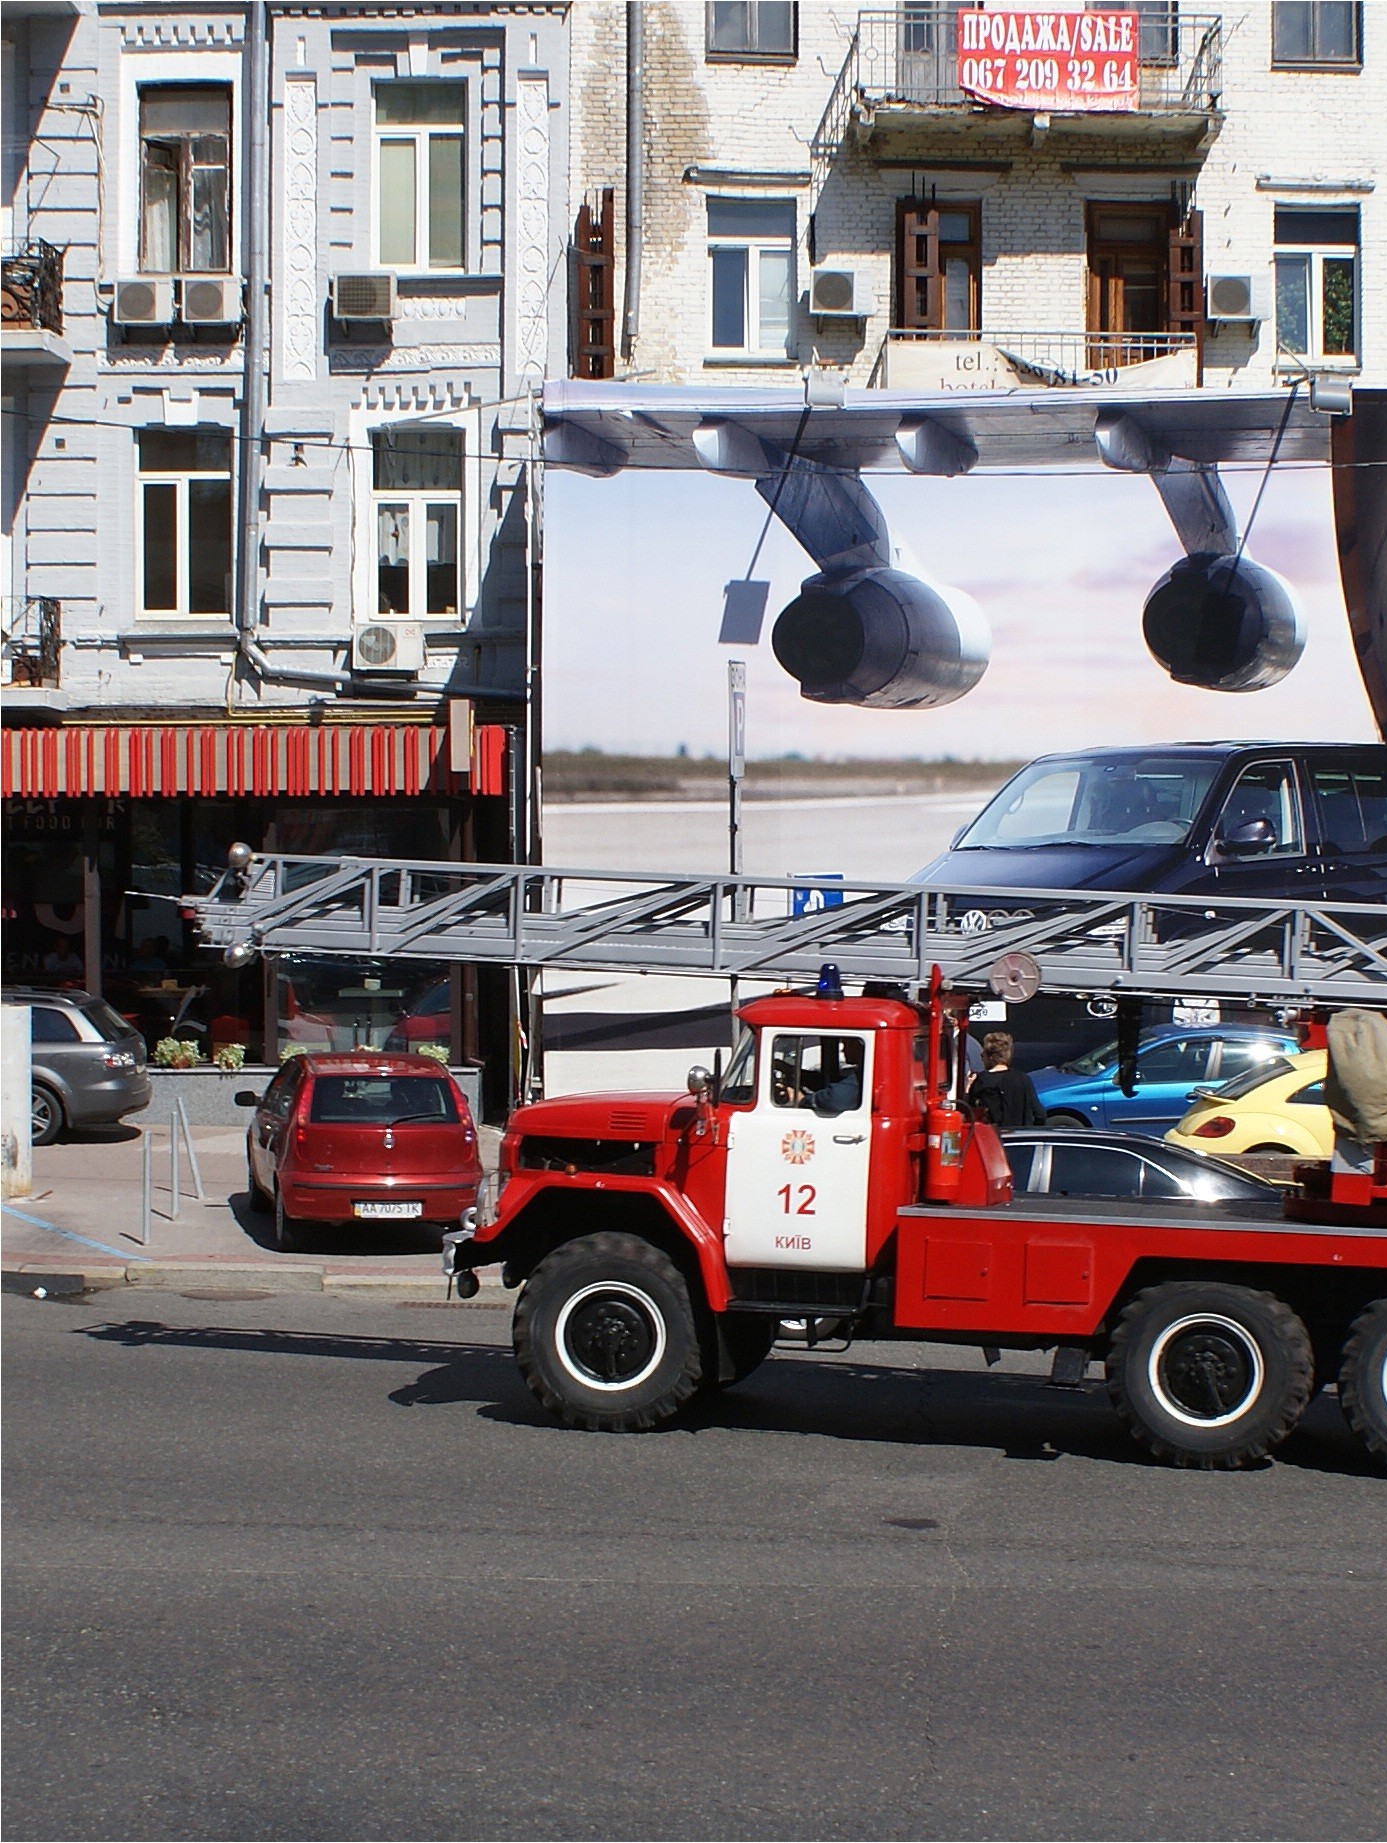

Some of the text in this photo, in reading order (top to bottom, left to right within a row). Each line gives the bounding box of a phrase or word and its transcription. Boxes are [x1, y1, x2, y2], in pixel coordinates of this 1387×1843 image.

[962, 13, 1134, 57] ПРОДАЖА/SALE
[963, 57, 1132, 92] 067 209 32 64
[956, 351, 998, 371] tel.:
[777, 1183, 817, 1215] 12
[775, 1235, 812, 1250] КИЇВ
